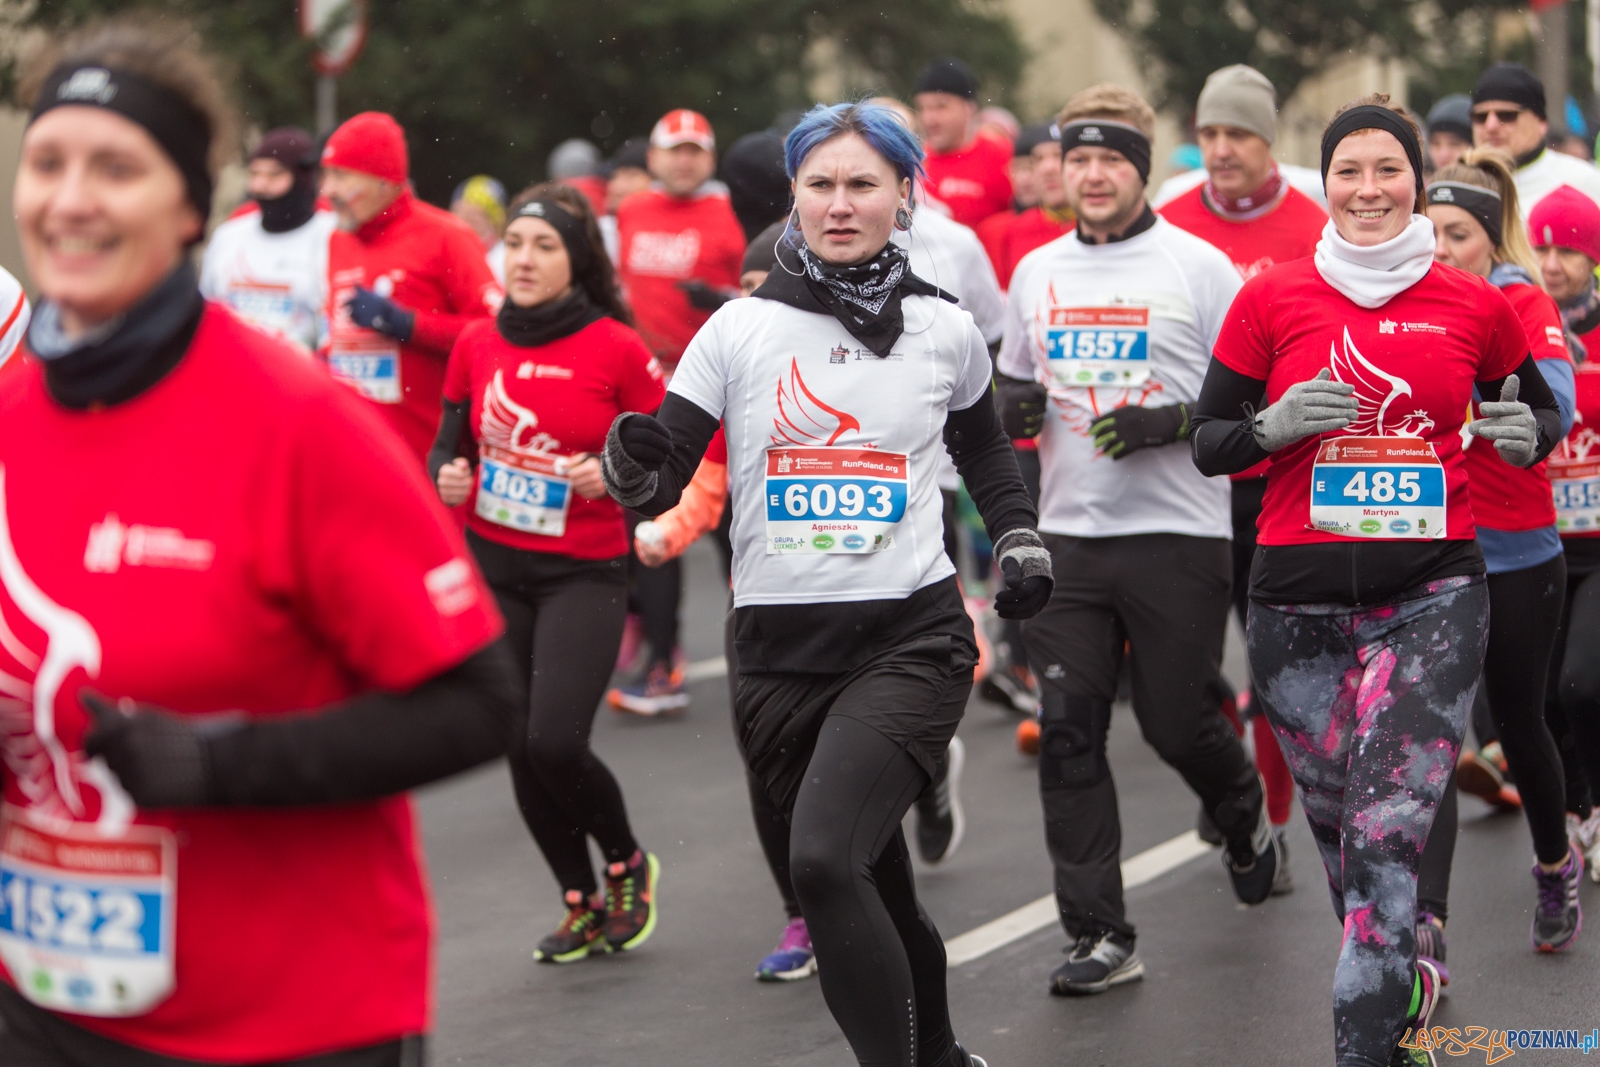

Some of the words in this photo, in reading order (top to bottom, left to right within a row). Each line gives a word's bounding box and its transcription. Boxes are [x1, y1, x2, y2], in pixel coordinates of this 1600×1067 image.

[1058, 331, 1138, 359] 1557
[842, 460, 899, 474] RunPoland.org
[490, 468, 548, 505] 803
[770, 494, 780, 506] E
[784, 483, 893, 518] 6093
[1316, 480, 1326, 492] E
[1343, 470, 1421, 502] 485
[1363, 508, 1400, 516] Martyna
[812, 524, 858, 532] Agnieszka
[7, 878, 146, 950] 1522
